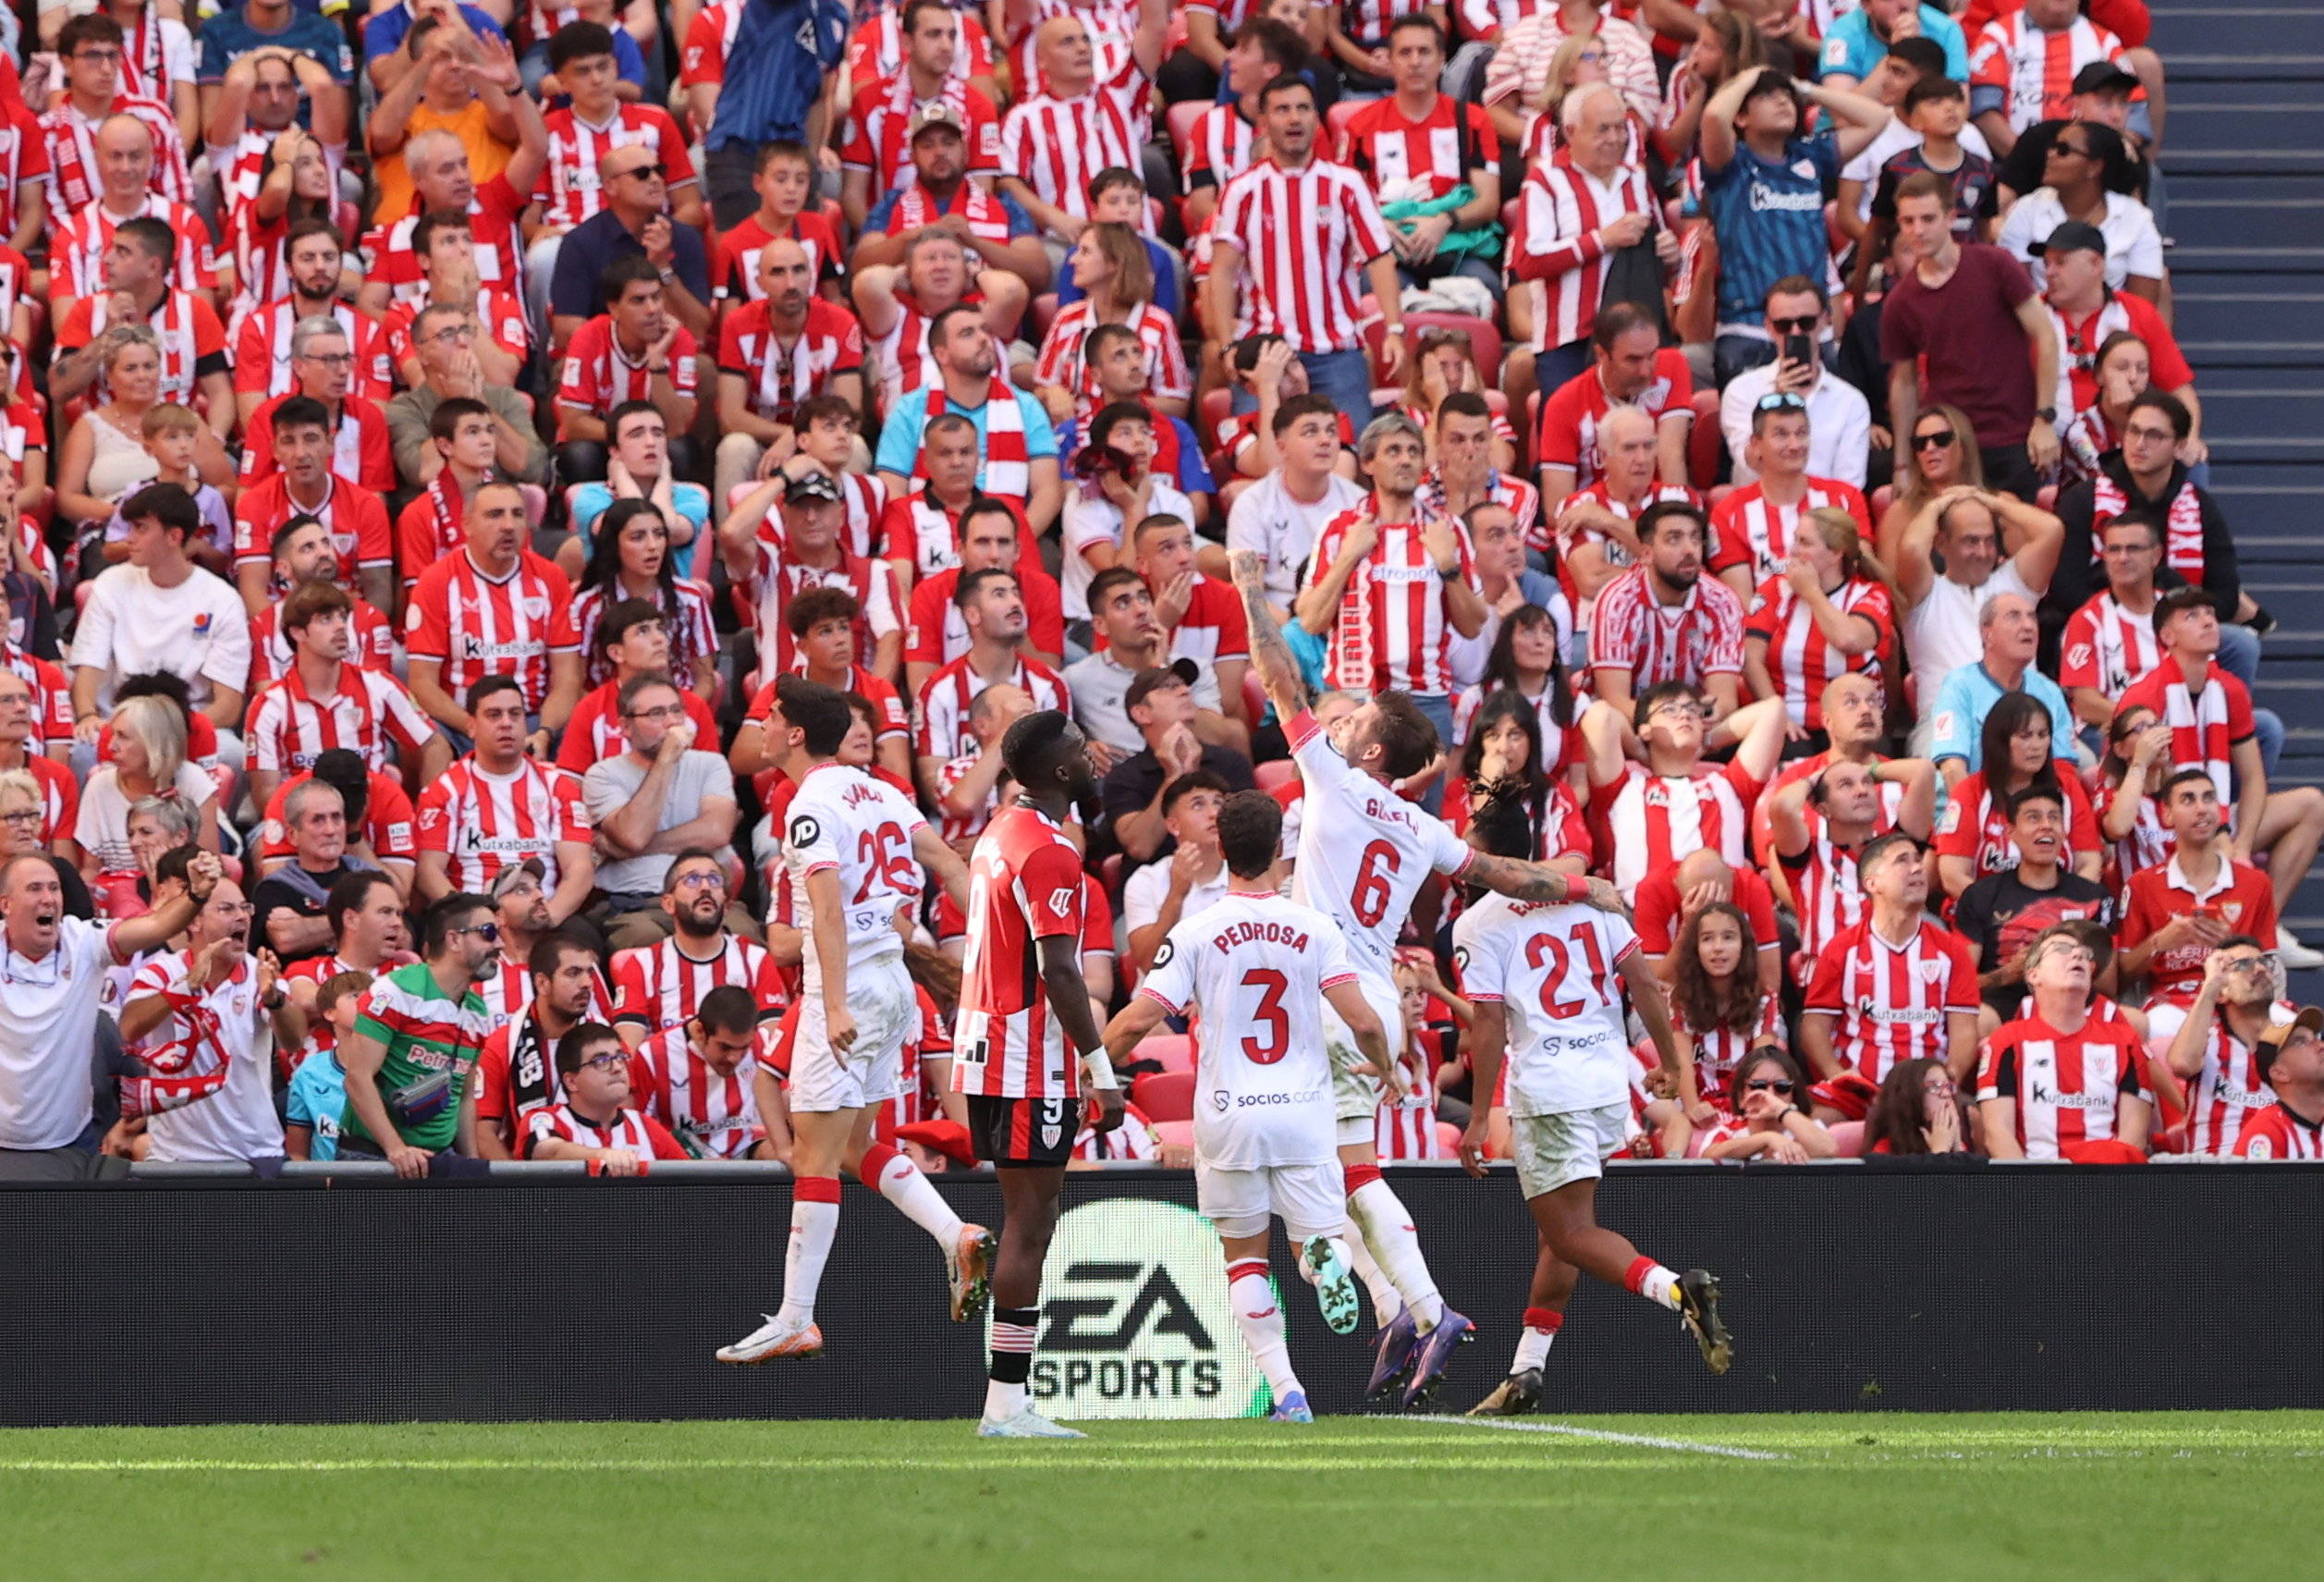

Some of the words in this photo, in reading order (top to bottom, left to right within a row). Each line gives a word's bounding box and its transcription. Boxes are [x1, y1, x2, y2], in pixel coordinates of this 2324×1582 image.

[794, 819, 817, 846] JD
[852, 821, 921, 905] 26
[1351, 839, 1401, 928] 6
[1214, 922, 1309, 955] PEDROSA
[1524, 921, 1610, 1020] 21
[1242, 968, 1289, 1065] 3
[2033, 1081, 2109, 1108] kutxabank
[2214, 1074, 2279, 1108] kutxaba
[1043, 1098, 1063, 1124] 9
[1036, 1260, 1217, 1351] EA
[1032, 1360, 1221, 1399] SPORTS
